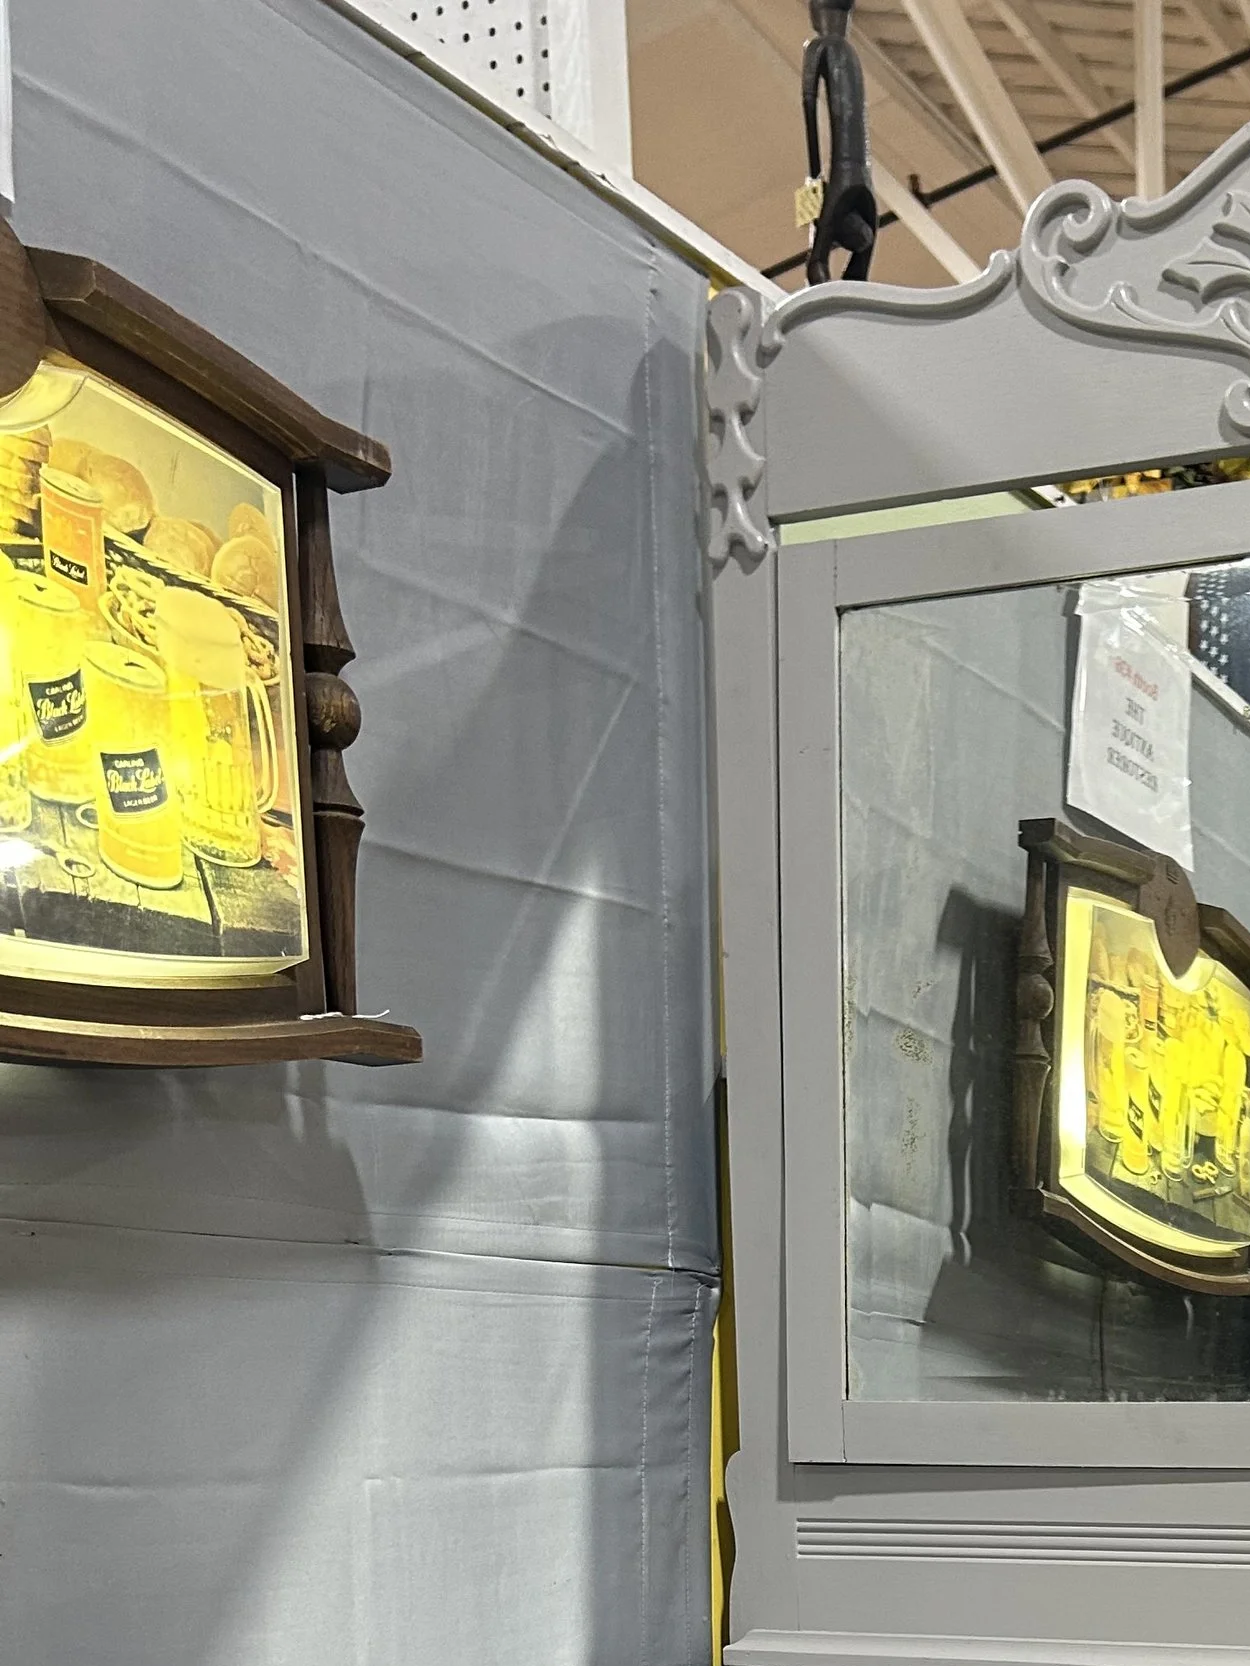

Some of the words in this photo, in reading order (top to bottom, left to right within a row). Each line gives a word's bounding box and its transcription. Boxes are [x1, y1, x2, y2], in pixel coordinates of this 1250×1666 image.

[36, 698, 68, 721] Black
[106, 769, 138, 793] Black
[135, 767, 162, 793] Label
